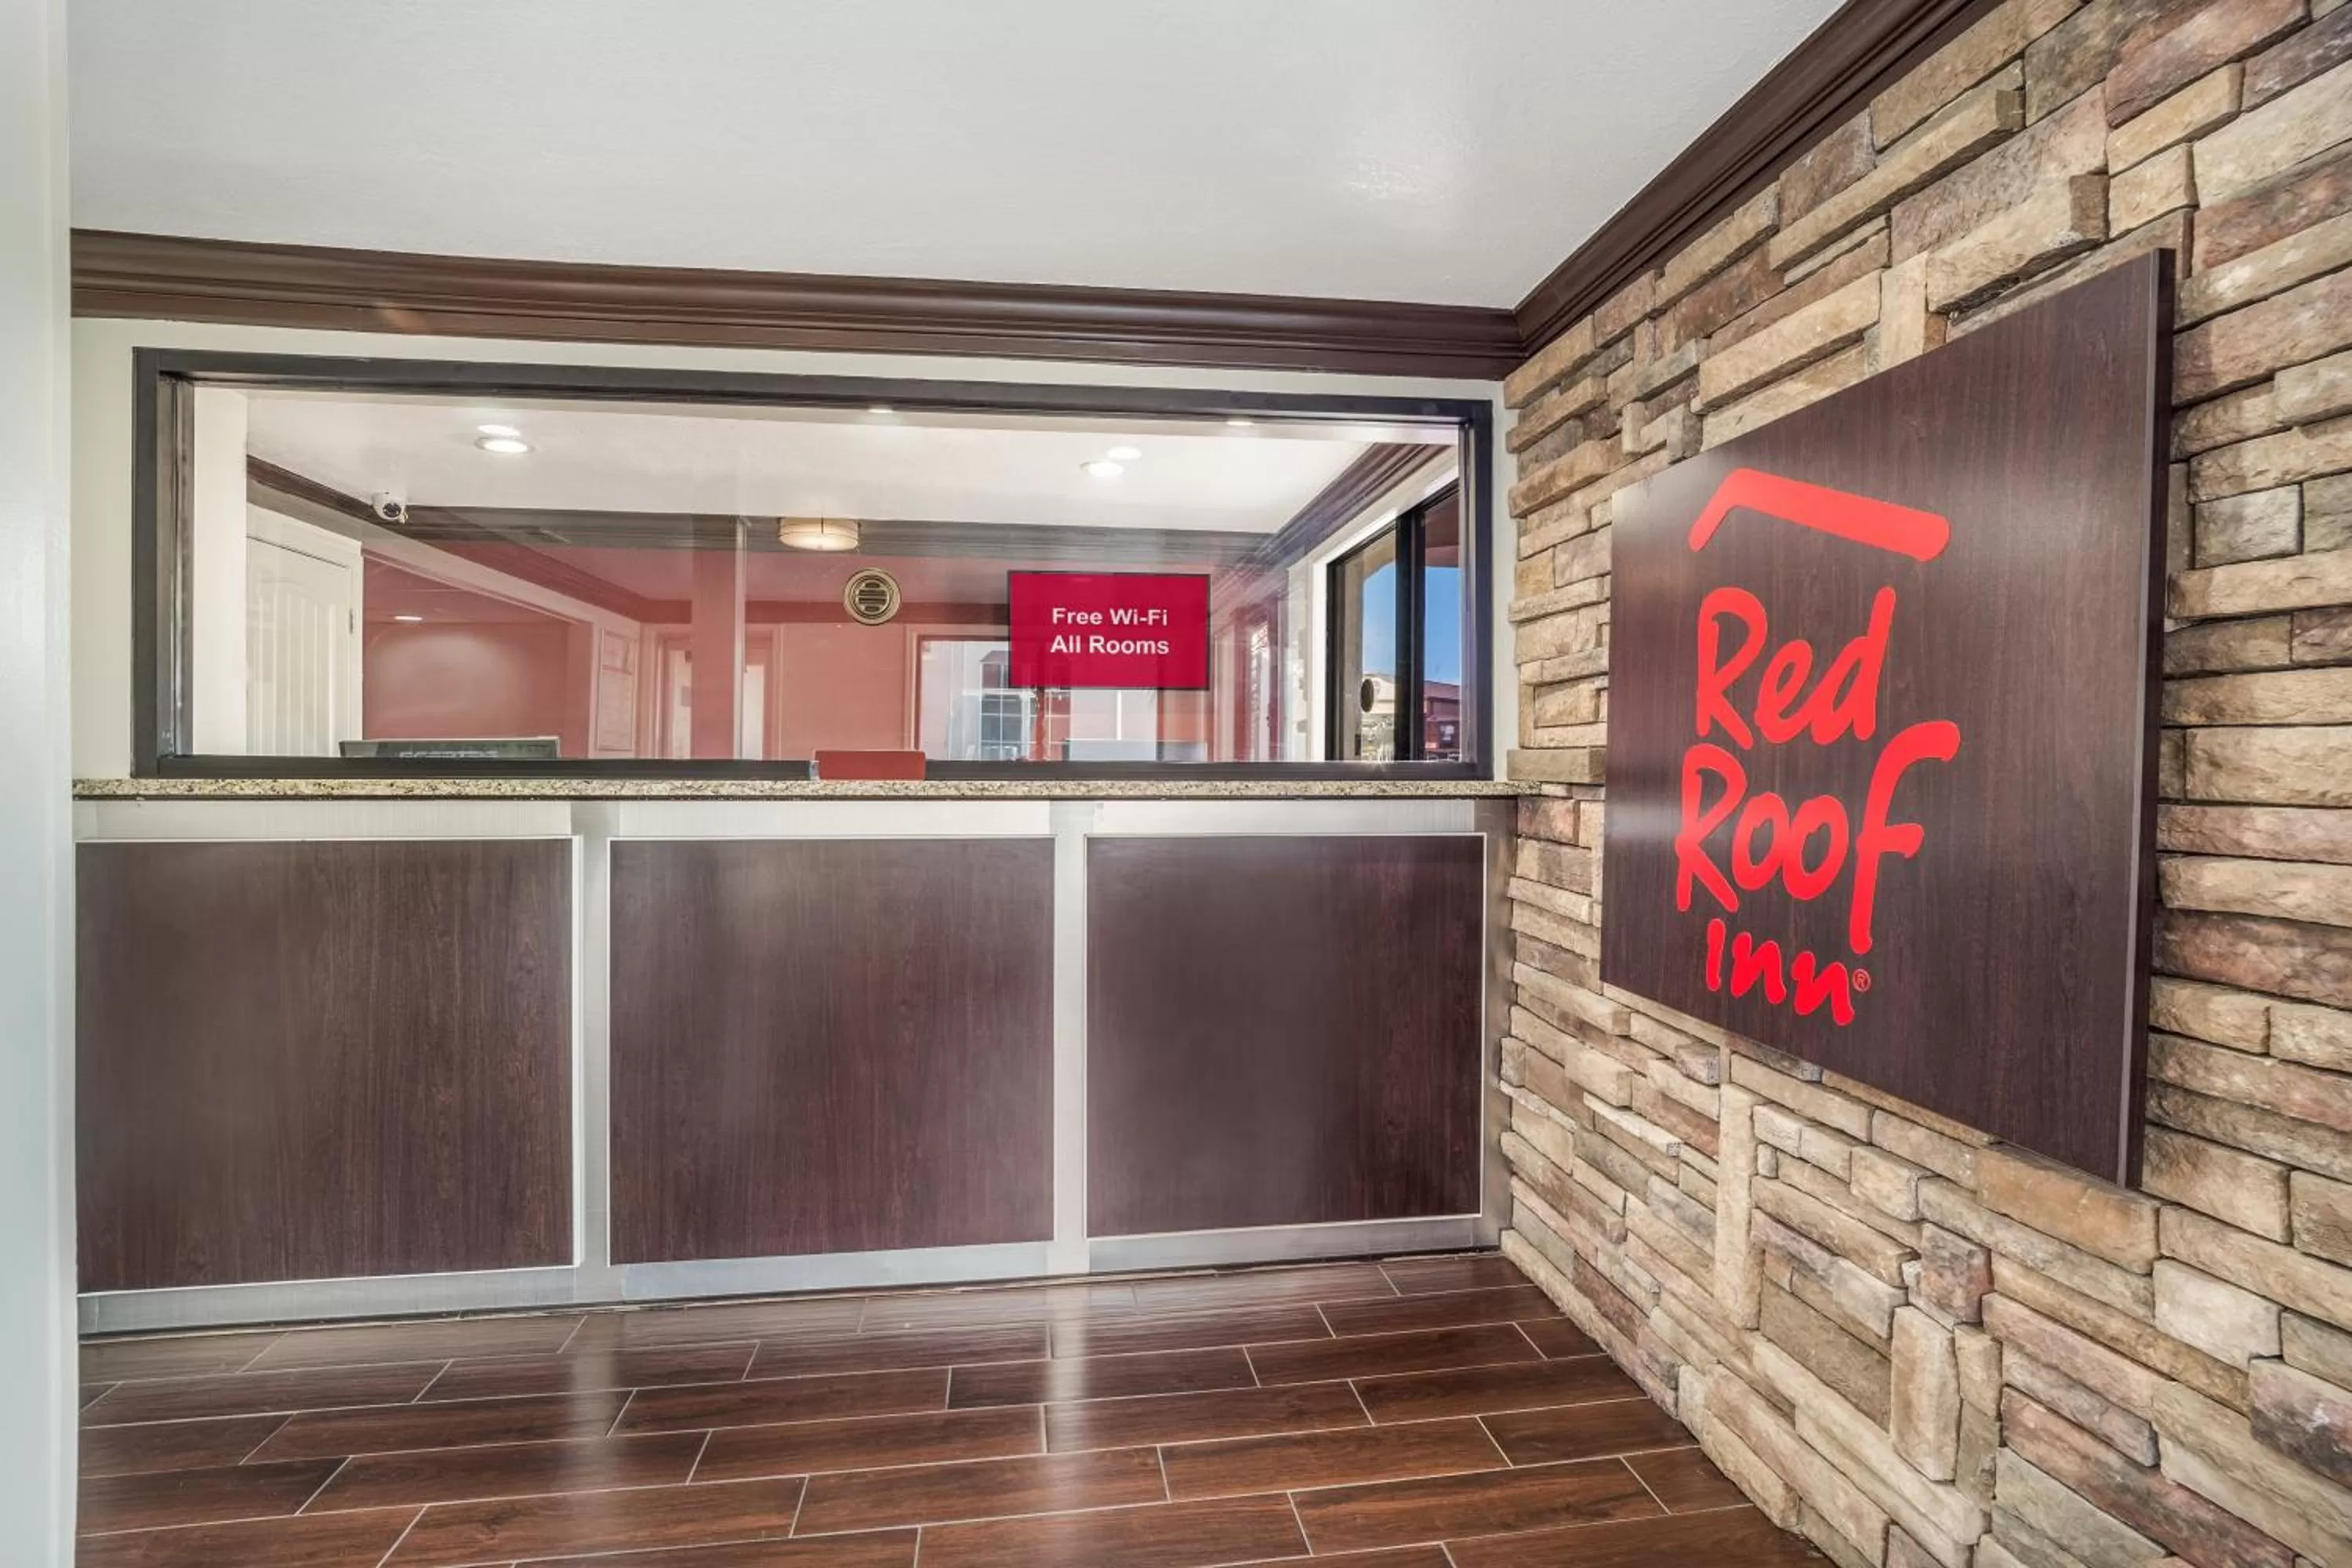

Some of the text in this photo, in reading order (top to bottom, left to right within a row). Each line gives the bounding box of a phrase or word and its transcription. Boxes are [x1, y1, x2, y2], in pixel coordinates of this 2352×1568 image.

[1050, 634, 1170, 655] All Rooms
[1051, 607, 1168, 626] Free Wi-Fi
[1696, 586, 1896, 750] Red
[1674, 720, 1961, 955] Roof
